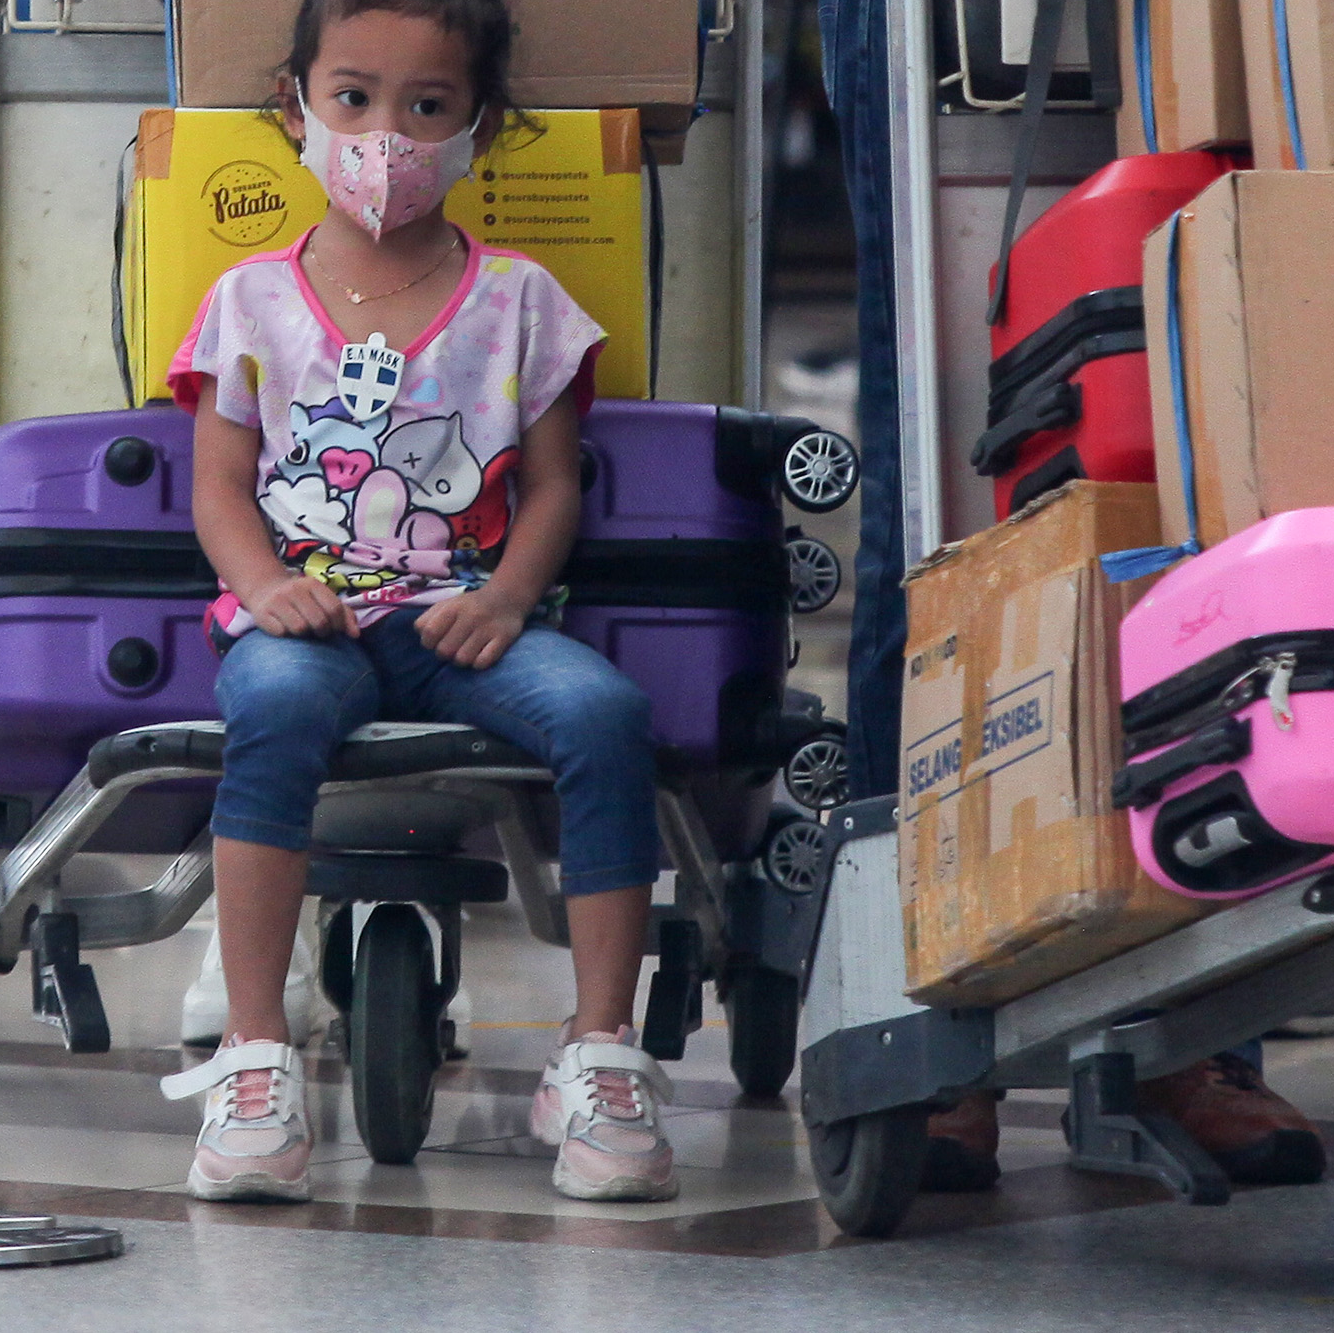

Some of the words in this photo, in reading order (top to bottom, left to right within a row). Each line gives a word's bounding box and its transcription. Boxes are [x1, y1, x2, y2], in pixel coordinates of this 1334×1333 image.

[212, 187, 286, 224] Patata
[369, 349, 401, 369] MASK
[981, 697, 1043, 758] EKSIBEL
